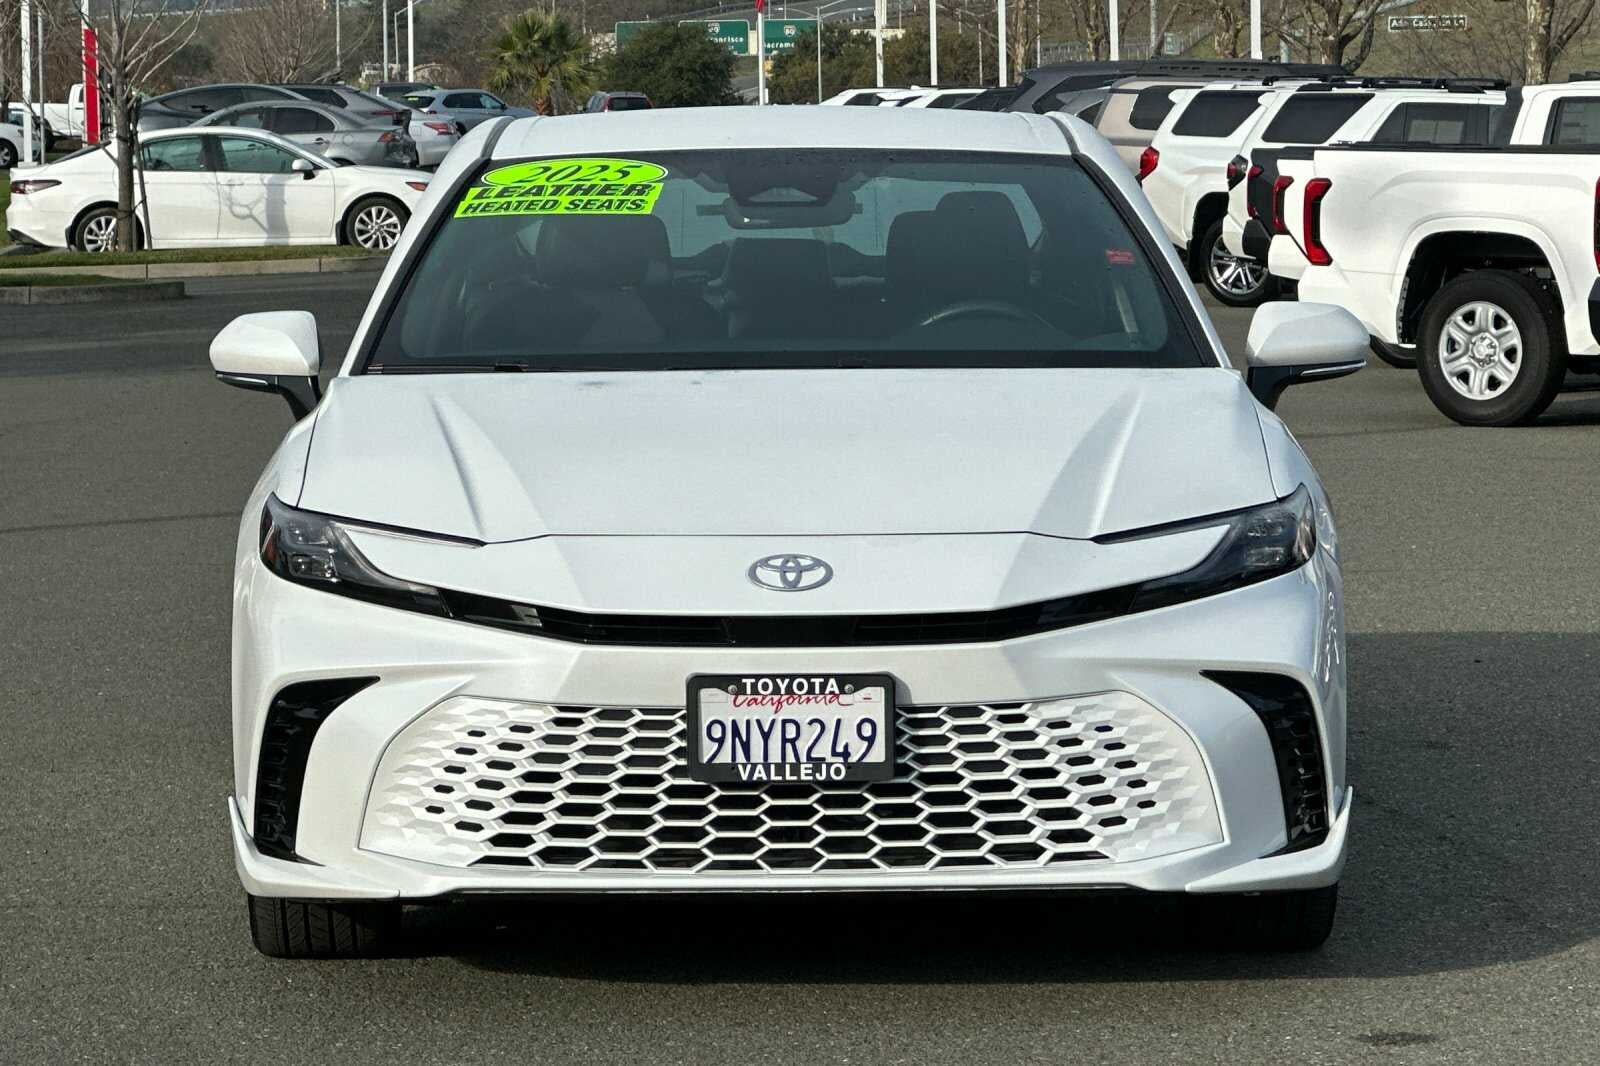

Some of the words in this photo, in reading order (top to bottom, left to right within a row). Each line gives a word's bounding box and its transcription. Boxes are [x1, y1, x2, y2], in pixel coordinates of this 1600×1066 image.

[512, 164, 642, 183] 2025
[473, 184, 655, 200] LEATHER
[460, 200, 559, 214] HEATED
[564, 199, 647, 213] SEATS
[741, 677, 840, 695] TOYOTA
[732, 693, 855, 714] California
[704, 717, 878, 764] 9NYR249
[737, 763, 847, 781] VALLEJO
